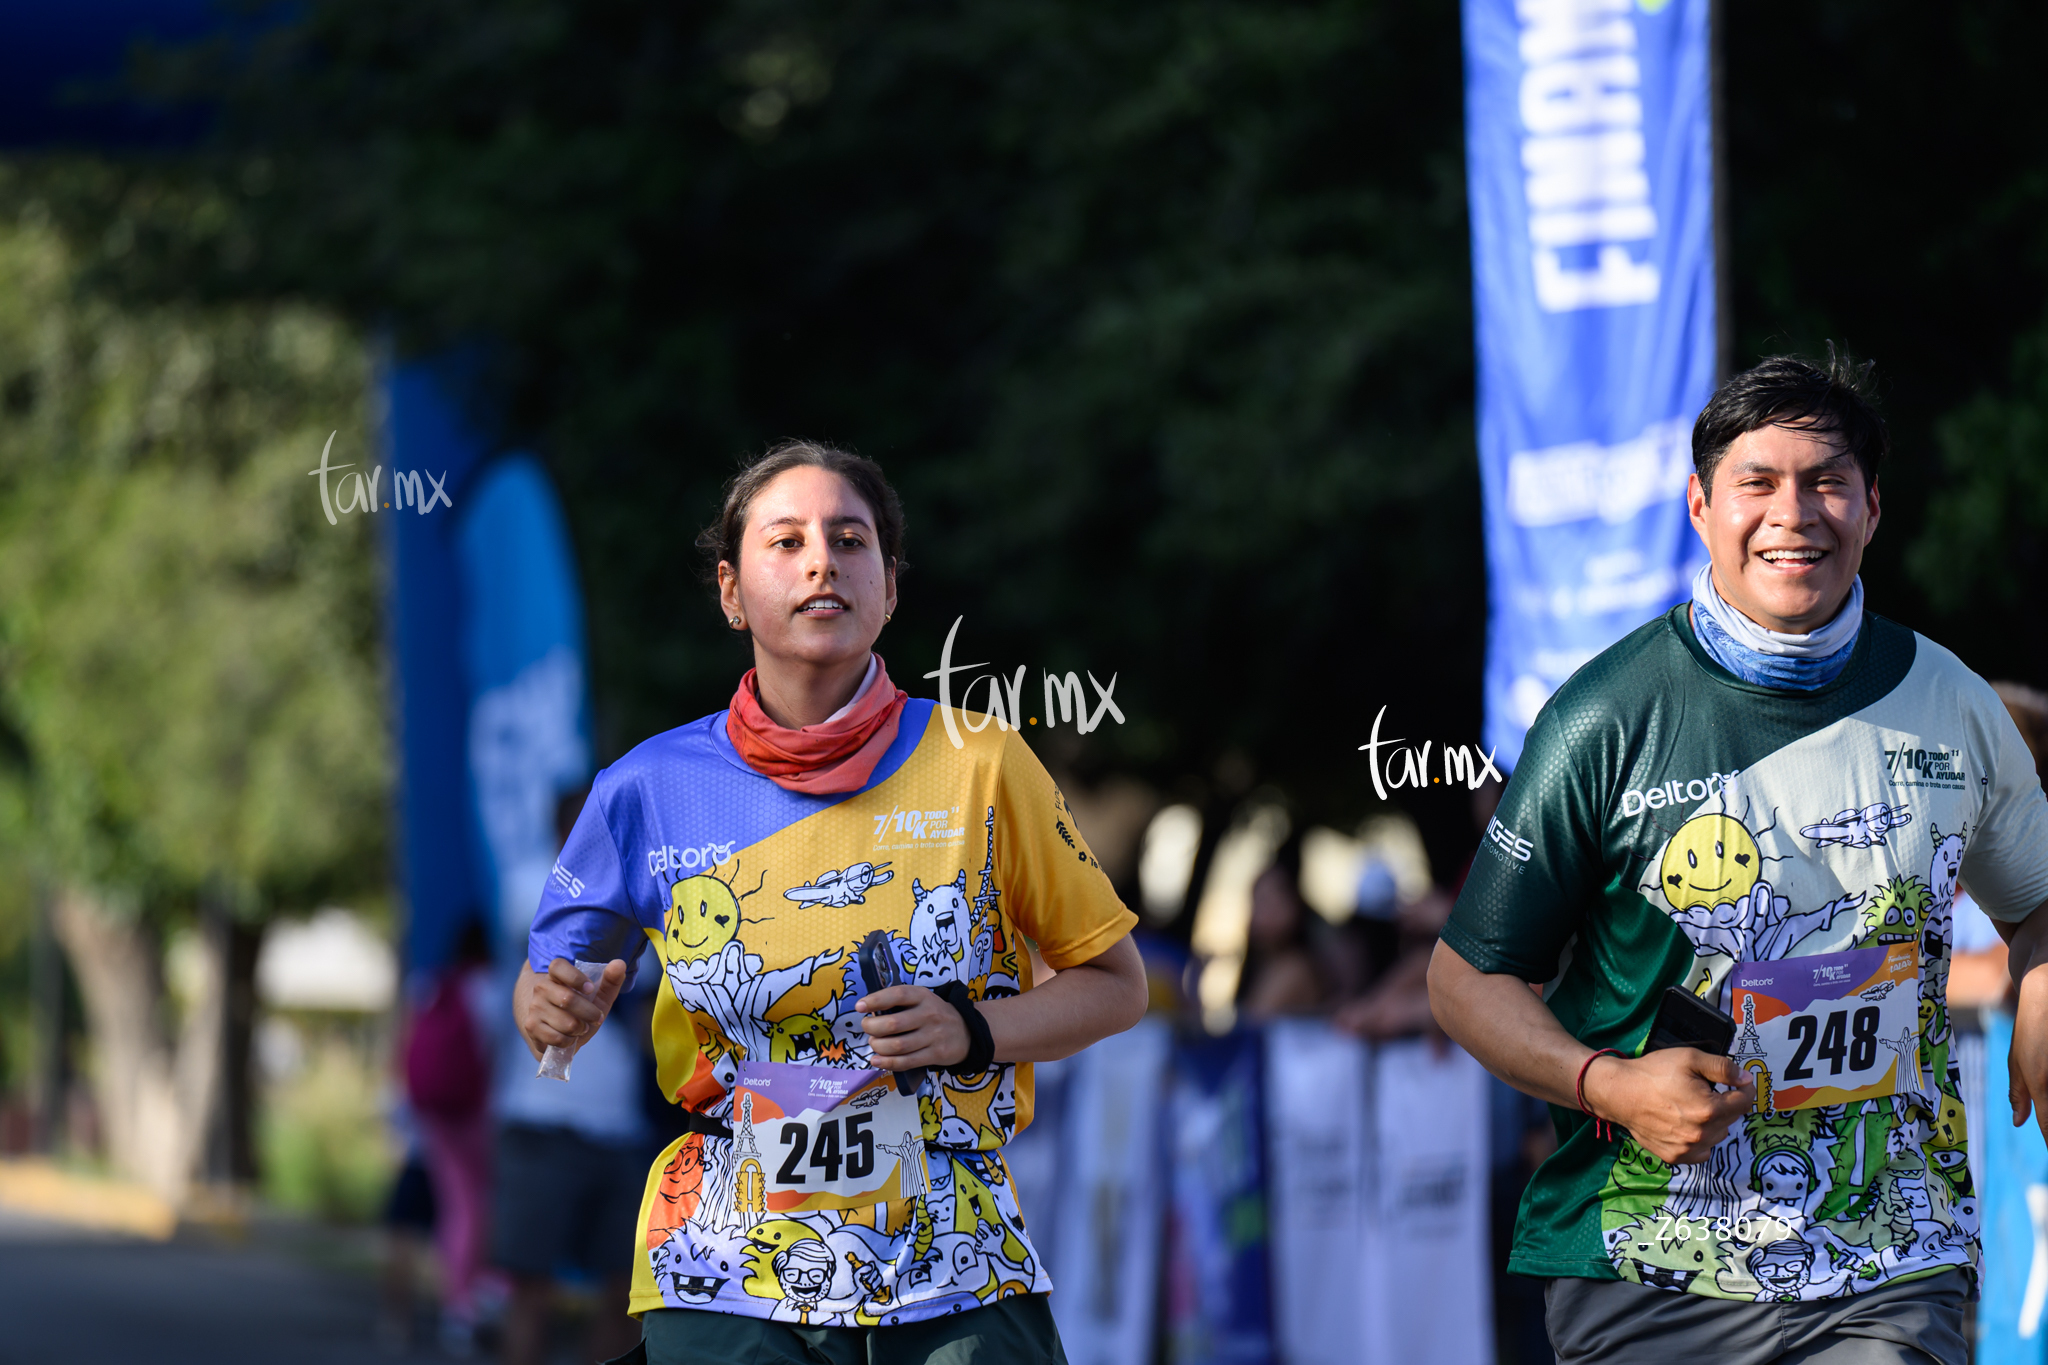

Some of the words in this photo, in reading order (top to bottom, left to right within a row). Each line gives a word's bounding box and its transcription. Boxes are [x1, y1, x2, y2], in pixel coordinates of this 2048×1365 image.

[1928, 752, 1949, 760] TODO
[1934, 762, 1950, 771] POR
[1936, 772, 1966, 781] AYUDAR
[924, 810, 949, 820] TODO
[930, 820, 949, 829] POR
[929, 827, 965, 839] AYUDAR
[1741, 977, 1775, 987] Deltoro
[1783, 1005, 1881, 1082] 248
[743, 1077, 772, 1087] Deltoro
[776, 1110, 875, 1185] 245
